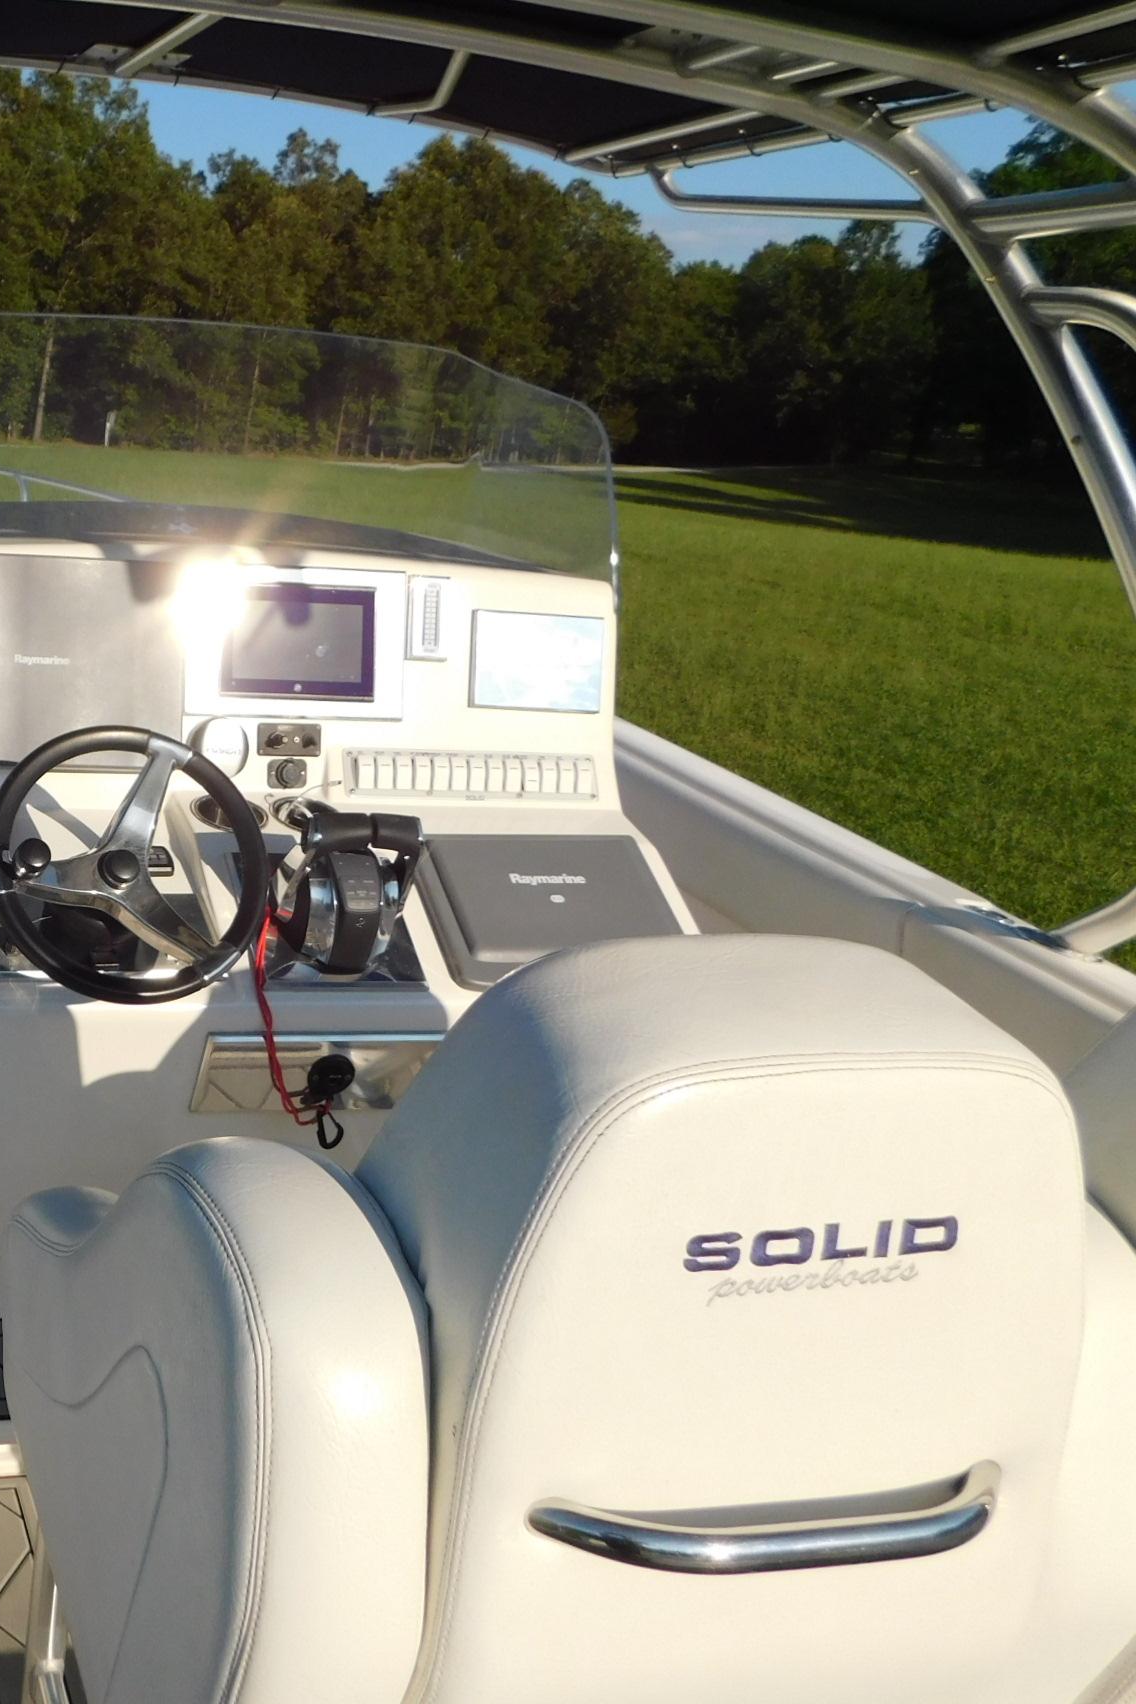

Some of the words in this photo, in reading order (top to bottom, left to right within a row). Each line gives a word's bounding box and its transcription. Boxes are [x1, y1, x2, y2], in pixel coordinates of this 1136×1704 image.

[14, 653, 71, 666] Raymarine
[508, 873, 587, 886] Raymarine
[682, 1215, 959, 1273] SOLID
[705, 1258, 920, 1308] powerboats
